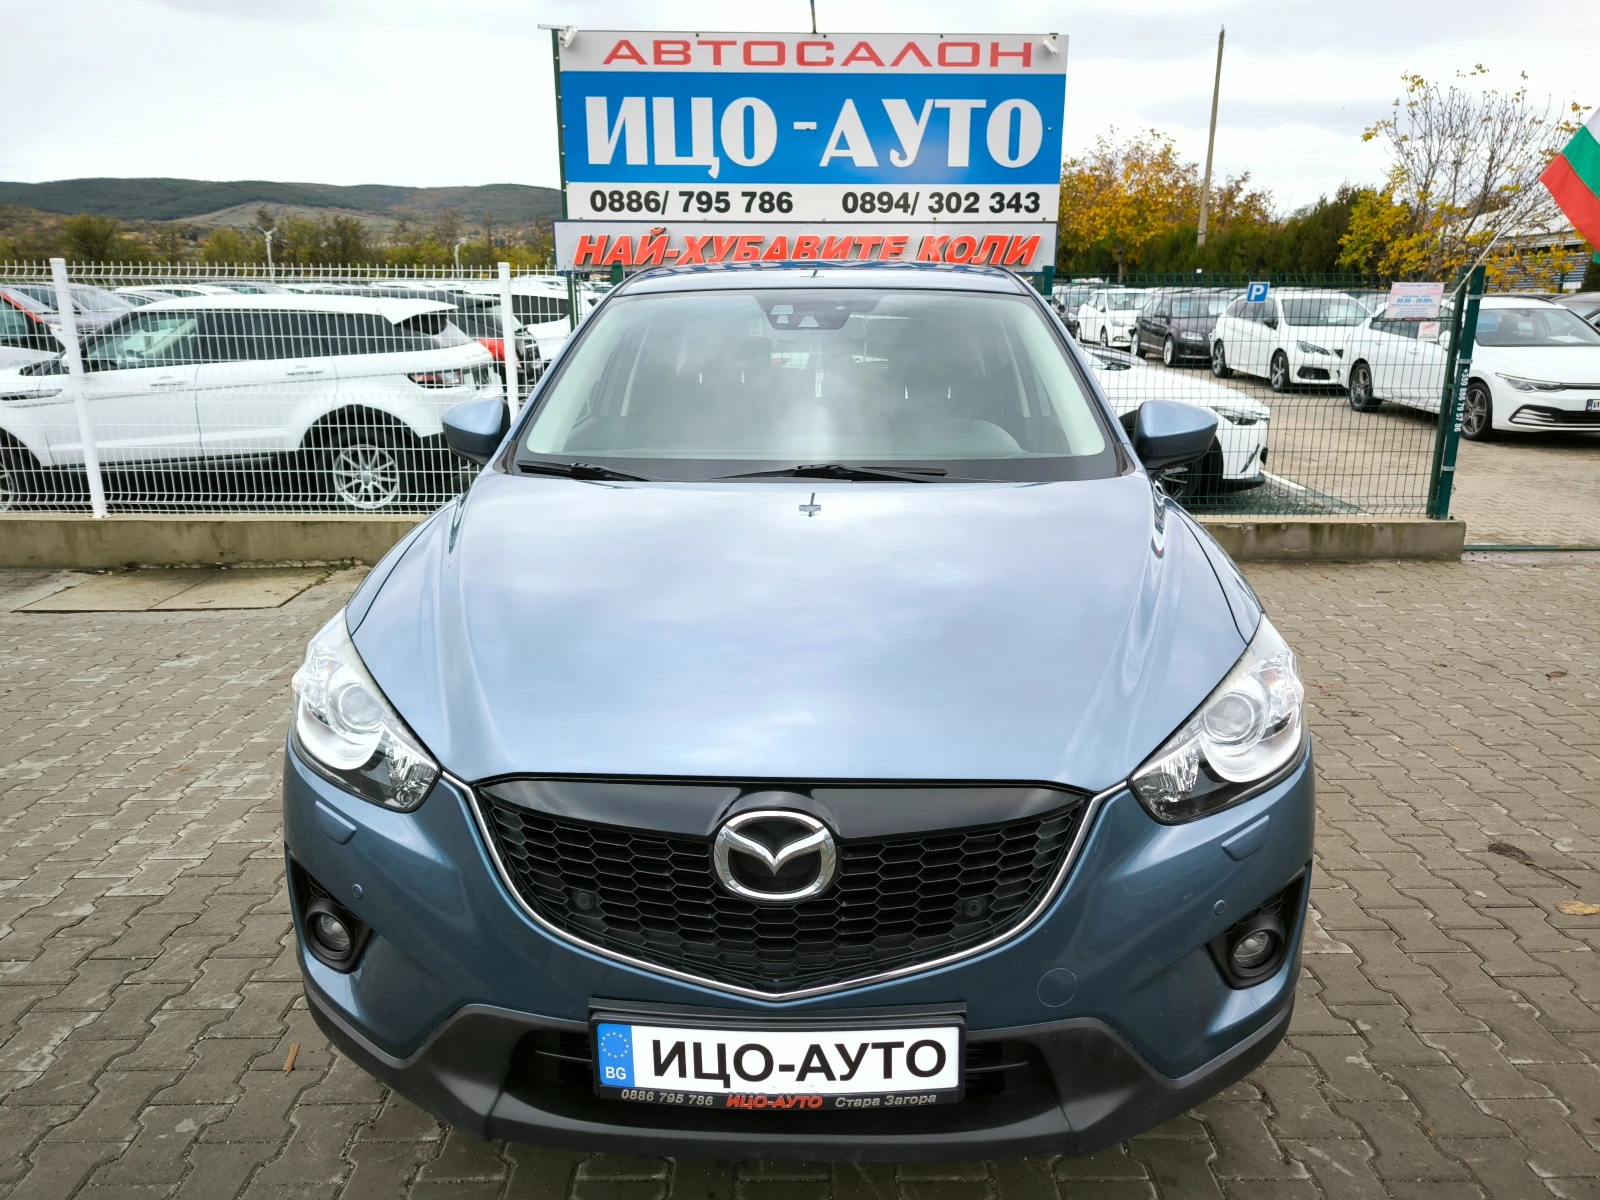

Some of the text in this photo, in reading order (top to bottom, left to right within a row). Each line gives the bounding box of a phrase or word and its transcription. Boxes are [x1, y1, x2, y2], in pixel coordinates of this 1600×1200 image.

[602, 39, 1032, 68] АВТОСАЛОН
[590, 189, 793, 215] 0886/ 795 786
[842, 191, 1041, 216] 0894/ 302 343
[573, 226, 1042, 266] НАЙ-ХУБАВИТЕ КОЛИ
[1250, 285, 1265, 300] P
[1456, 402, 1465, 411] 79
[1455, 413, 1463, 421] 57
[1453, 423, 1462, 432] 86
[652, 1039, 947, 1088] ИЦО-АУТО
[605, 1066, 627, 1080] BG
[620, 1089, 714, 1106] 0886 795 786
[726, 1094, 823, 1109] ИЦО-АУТО
[835, 1094, 937, 1108] Стара Загора
